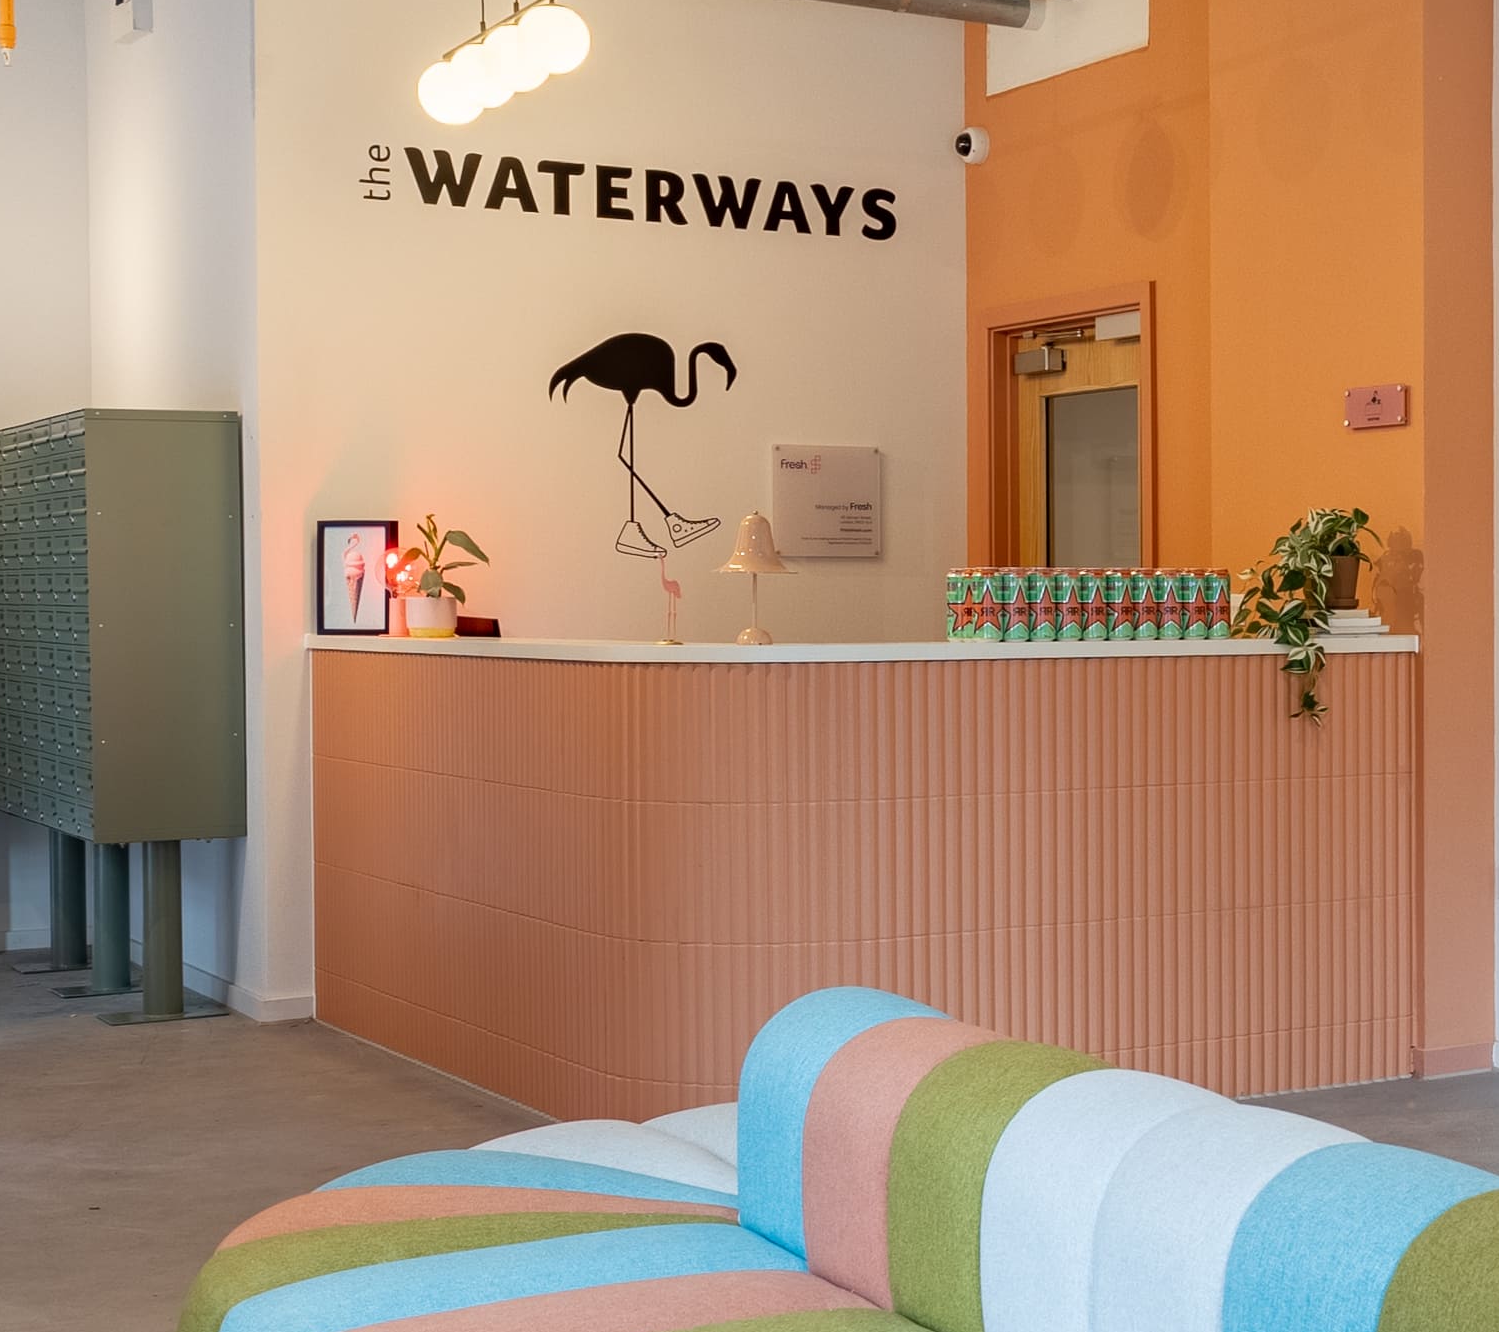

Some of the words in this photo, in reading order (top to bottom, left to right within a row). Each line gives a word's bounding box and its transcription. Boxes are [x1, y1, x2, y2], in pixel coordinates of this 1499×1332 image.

[358, 144, 392, 201] the
[403, 146, 898, 241] WATERWAYS
[780, 458, 808, 470] Fresh
[850, 502, 873, 511] Fresh
